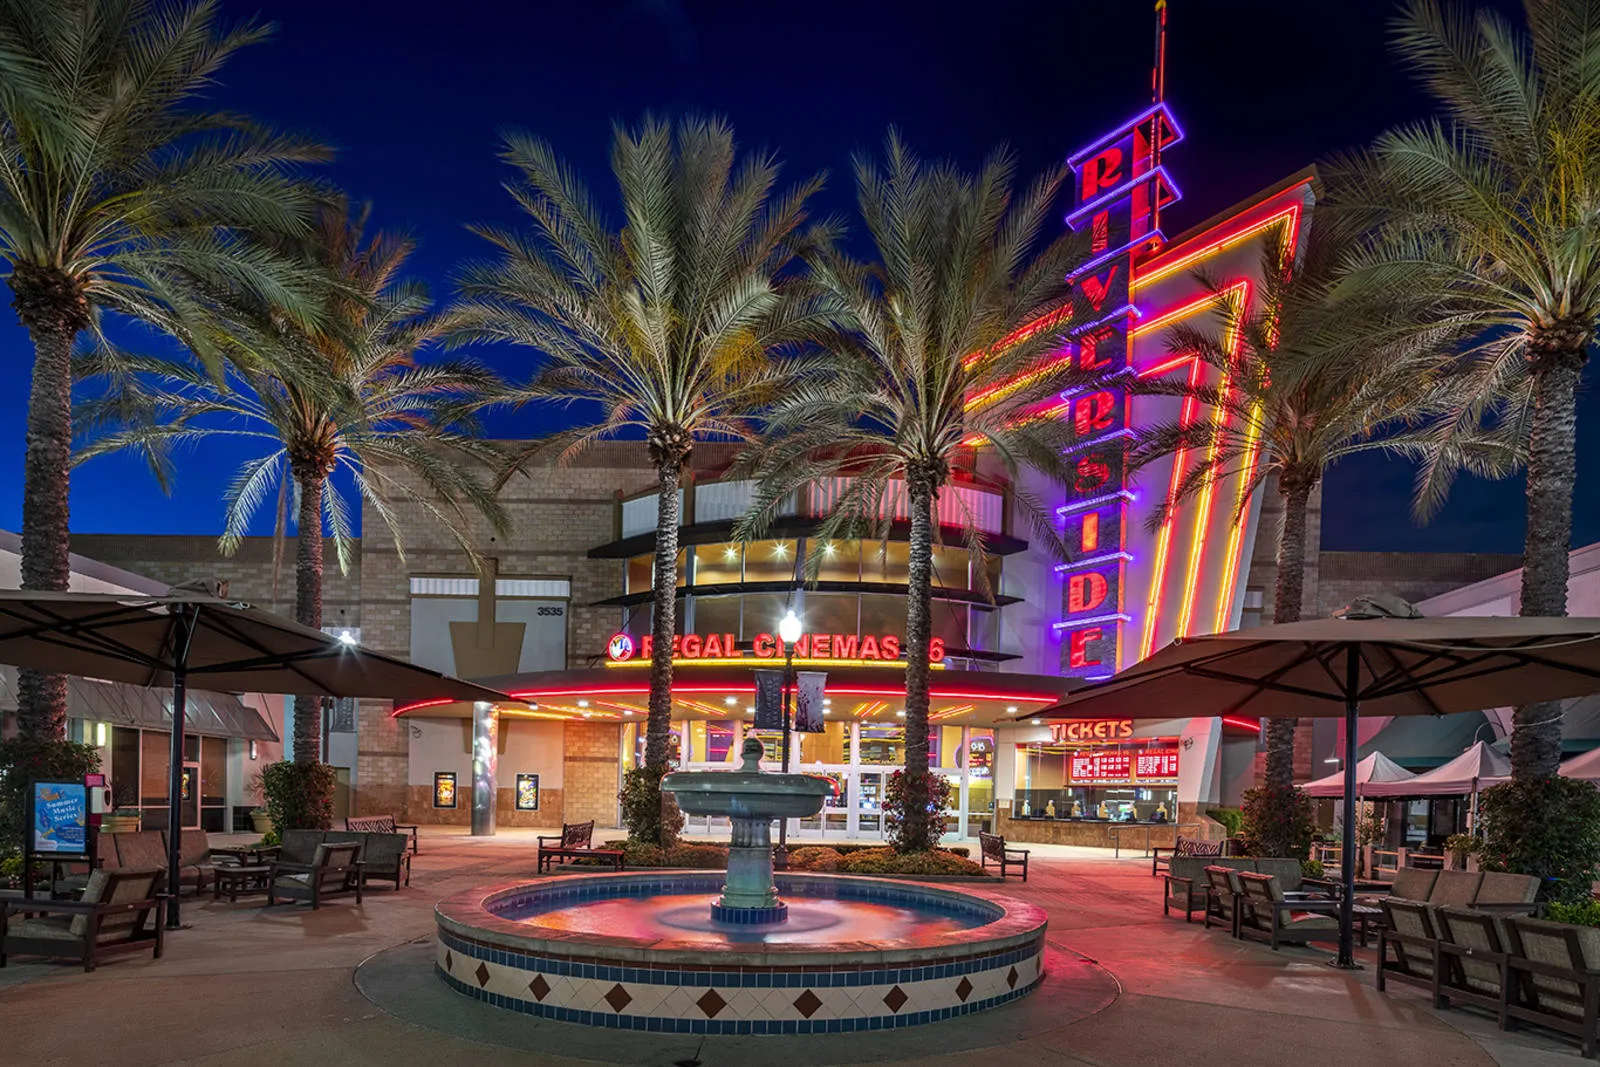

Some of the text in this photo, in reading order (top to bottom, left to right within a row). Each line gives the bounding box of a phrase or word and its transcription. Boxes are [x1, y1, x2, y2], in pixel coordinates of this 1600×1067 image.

[1070, 146, 1123, 669] RIVERSIDE
[537, 607, 563, 617] 3535
[753, 633, 901, 661] CINEMAS
[1049, 720, 1134, 740] TICKETS
[46, 798, 78, 809] Summer
[53, 805, 76, 815] Music
[54, 814, 78, 823] Series
